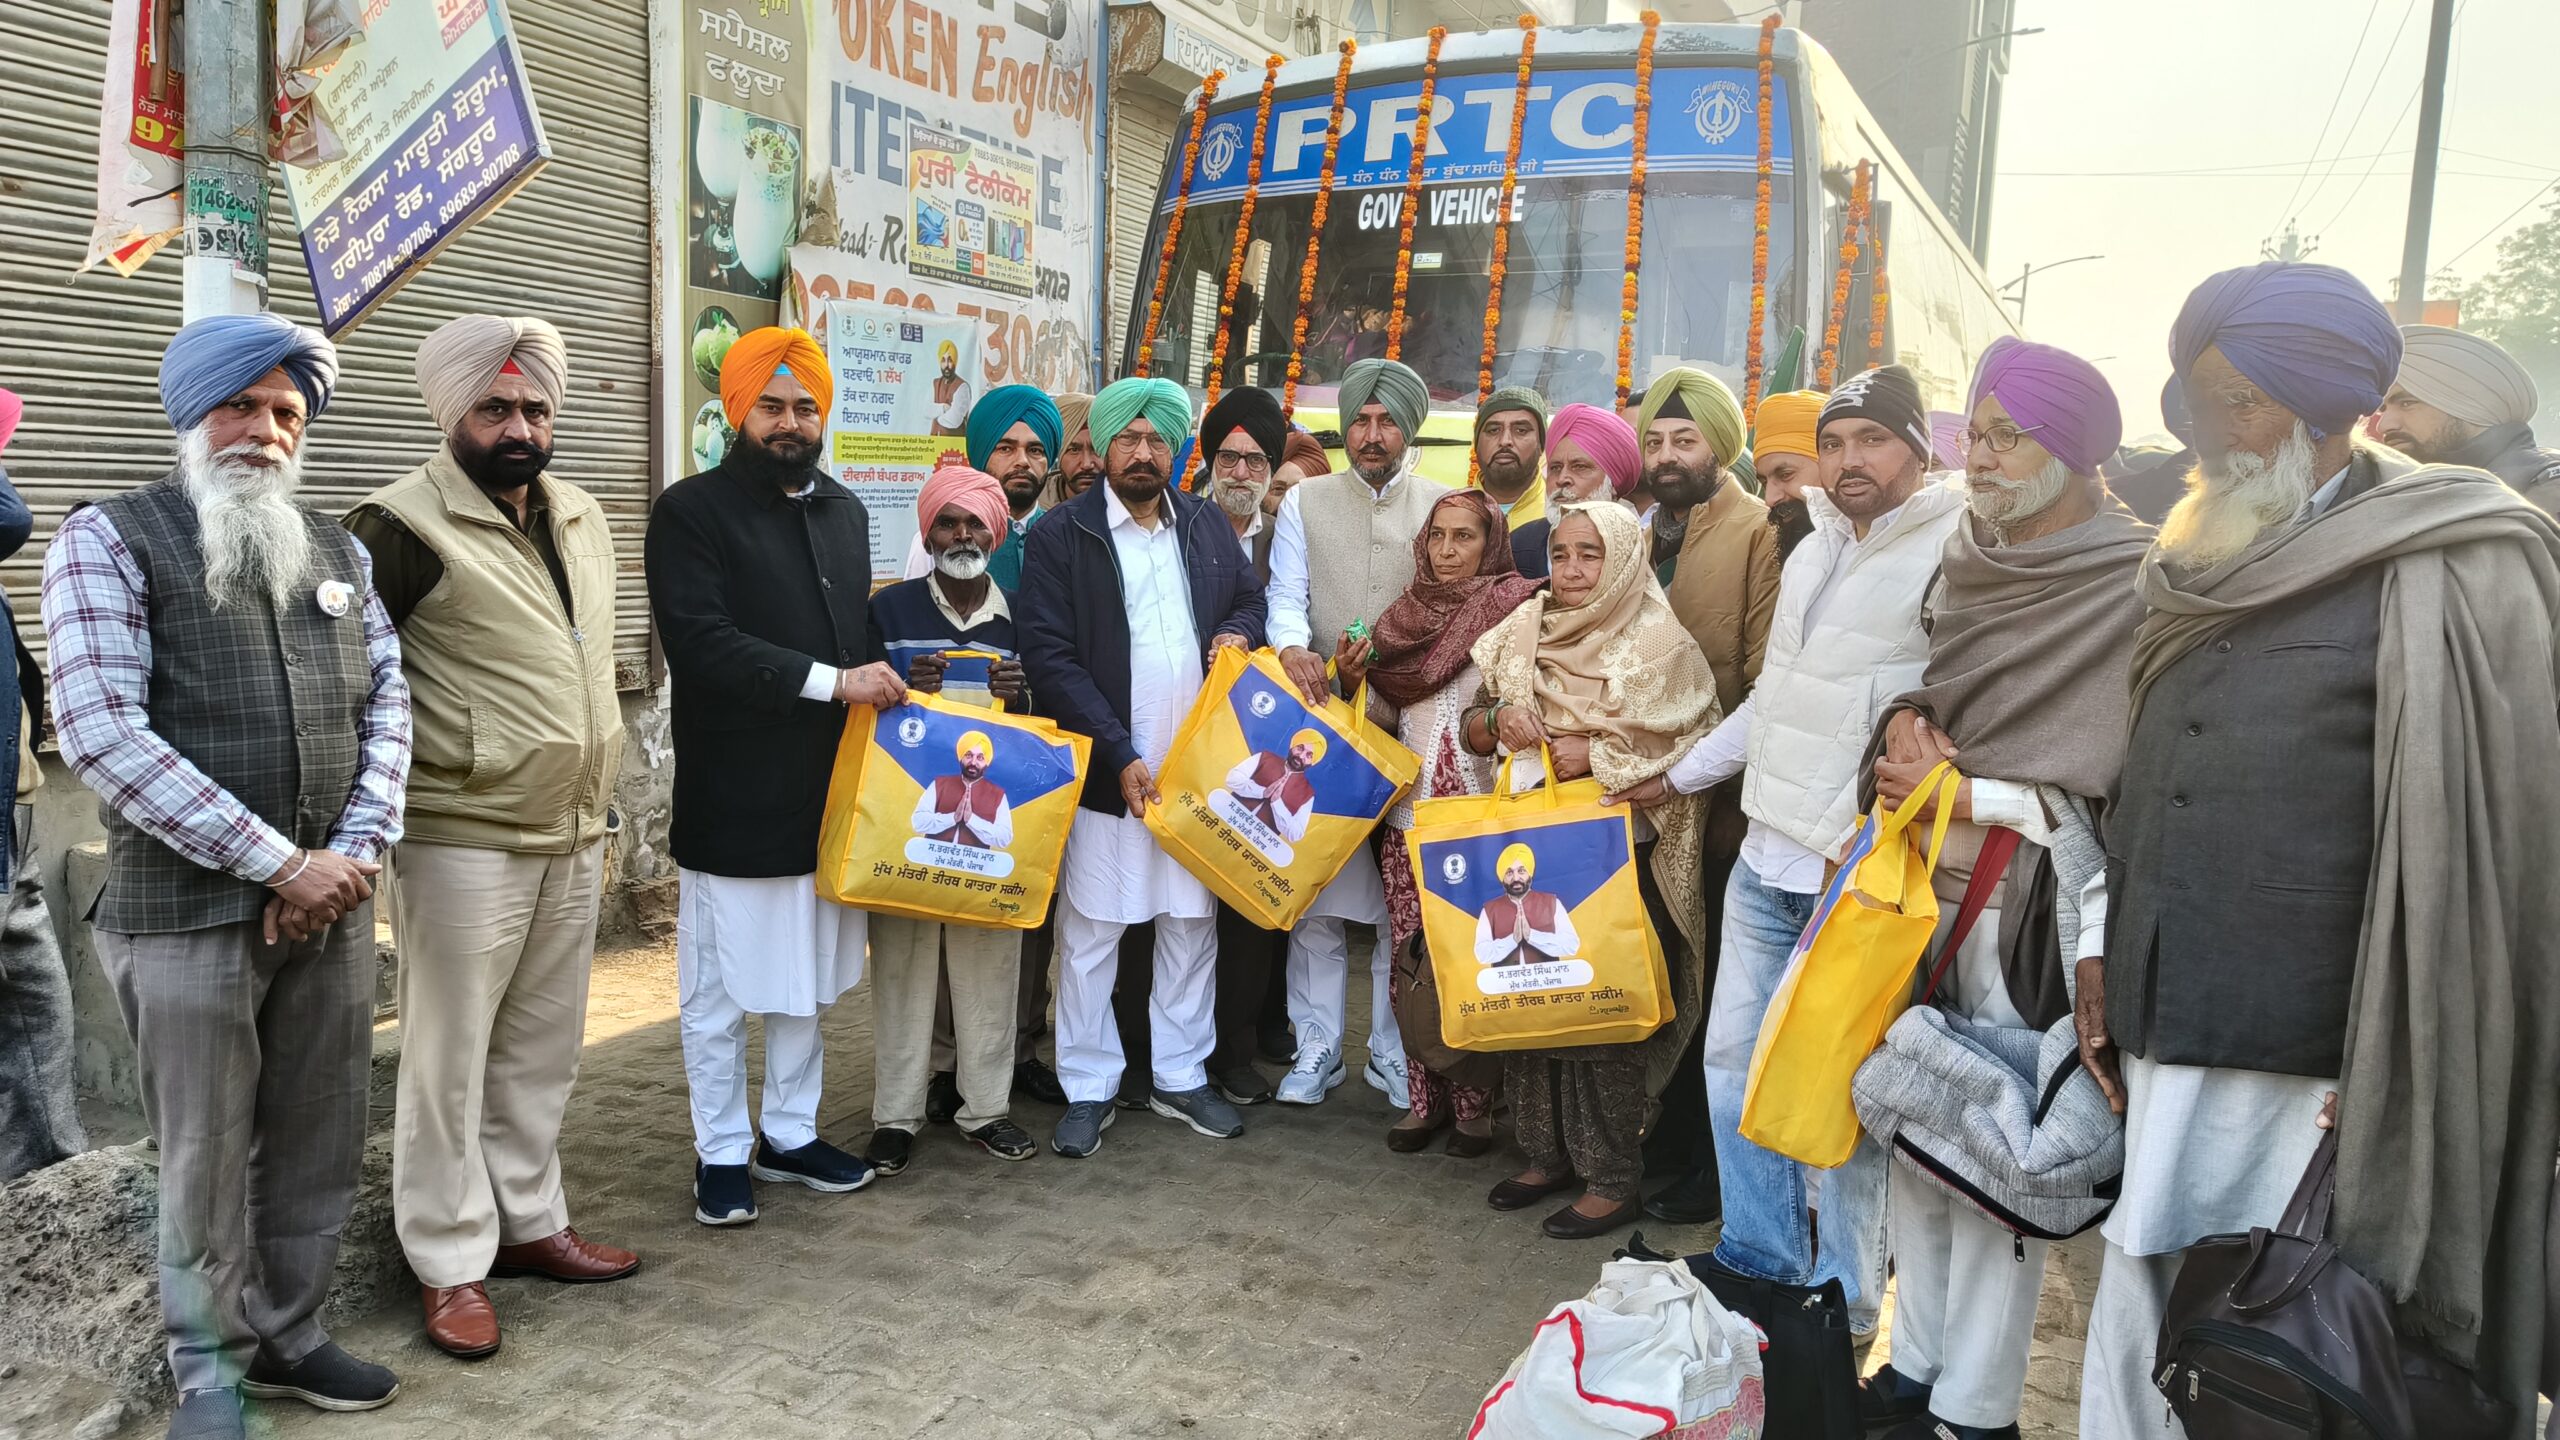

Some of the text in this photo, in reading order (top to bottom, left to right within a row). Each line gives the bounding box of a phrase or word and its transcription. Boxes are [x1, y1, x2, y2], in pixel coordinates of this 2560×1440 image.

[698, 7, 792, 63] ਸਪੈਸ਼ਲ
[704, 50, 786, 100] ਫਲੂਦਾ
[832, 0, 958, 99] OKEN
[972, 24, 1093, 155] English
[1272, 82, 1637, 172] PRTC
[313, 216, 340, 253] ਨੇੜੇ
[342, 170, 389, 225] ਨੈਕਸਾ
[394, 110, 449, 178] ਮਾਰੂਤੀ
[439, 143, 520, 225] 89689-80708
[917, 155, 957, 189] ਪੁਰੀ
[1352, 169, 1374, 183] ਧੰਨ
[1379, 167, 1401, 181] ਧੰਨ
[331, 215, 390, 280] ਹਰੀਪੁਰਾ
[437, 116, 497, 183] ਸੰਗਰੂਰ
[1358, 191, 1417, 230] GOV.
[839, 218, 878, 259] ead:-
[887, 351, 912, 365] ਕਾਰਡ
[877, 369, 882, 383] 1
[842, 386, 895, 405] ਤੱਕ ਦਾ ਨਗਦ
[842, 407, 870, 424] ਇਨਾਮ
[877, 467, 899, 482] ਬੰਪਰ
[981, 852, 996, 862] ਮਾਨ
[1178, 791, 1195, 808] ਮੁੱਖ
[1192, 805, 1219, 830] ਮੰਤਰੀ
[1217, 827, 1243, 851] ਤੀਰਥ
[1241, 849, 1270, 873] ਯਾਤਰਾ
[1268, 872, 1294, 896] ਸਕੀਮ
[1269, 835, 1281, 849] ਮਾਨ
[873, 860, 1027, 896] ਮੁੱਖ ਮੰਤਰੀ ਤੀਰਥ ਯਾਤਰਾ ਸਕੀਮ
[1554, 964, 1570, 974] ਮਾਨ
[1458, 986, 1625, 1017] ਮੁੱਖ ਮੰਤਰੀ ਤੀਰਥ ਯਾਤਰਾ ਸਕੀਮ
